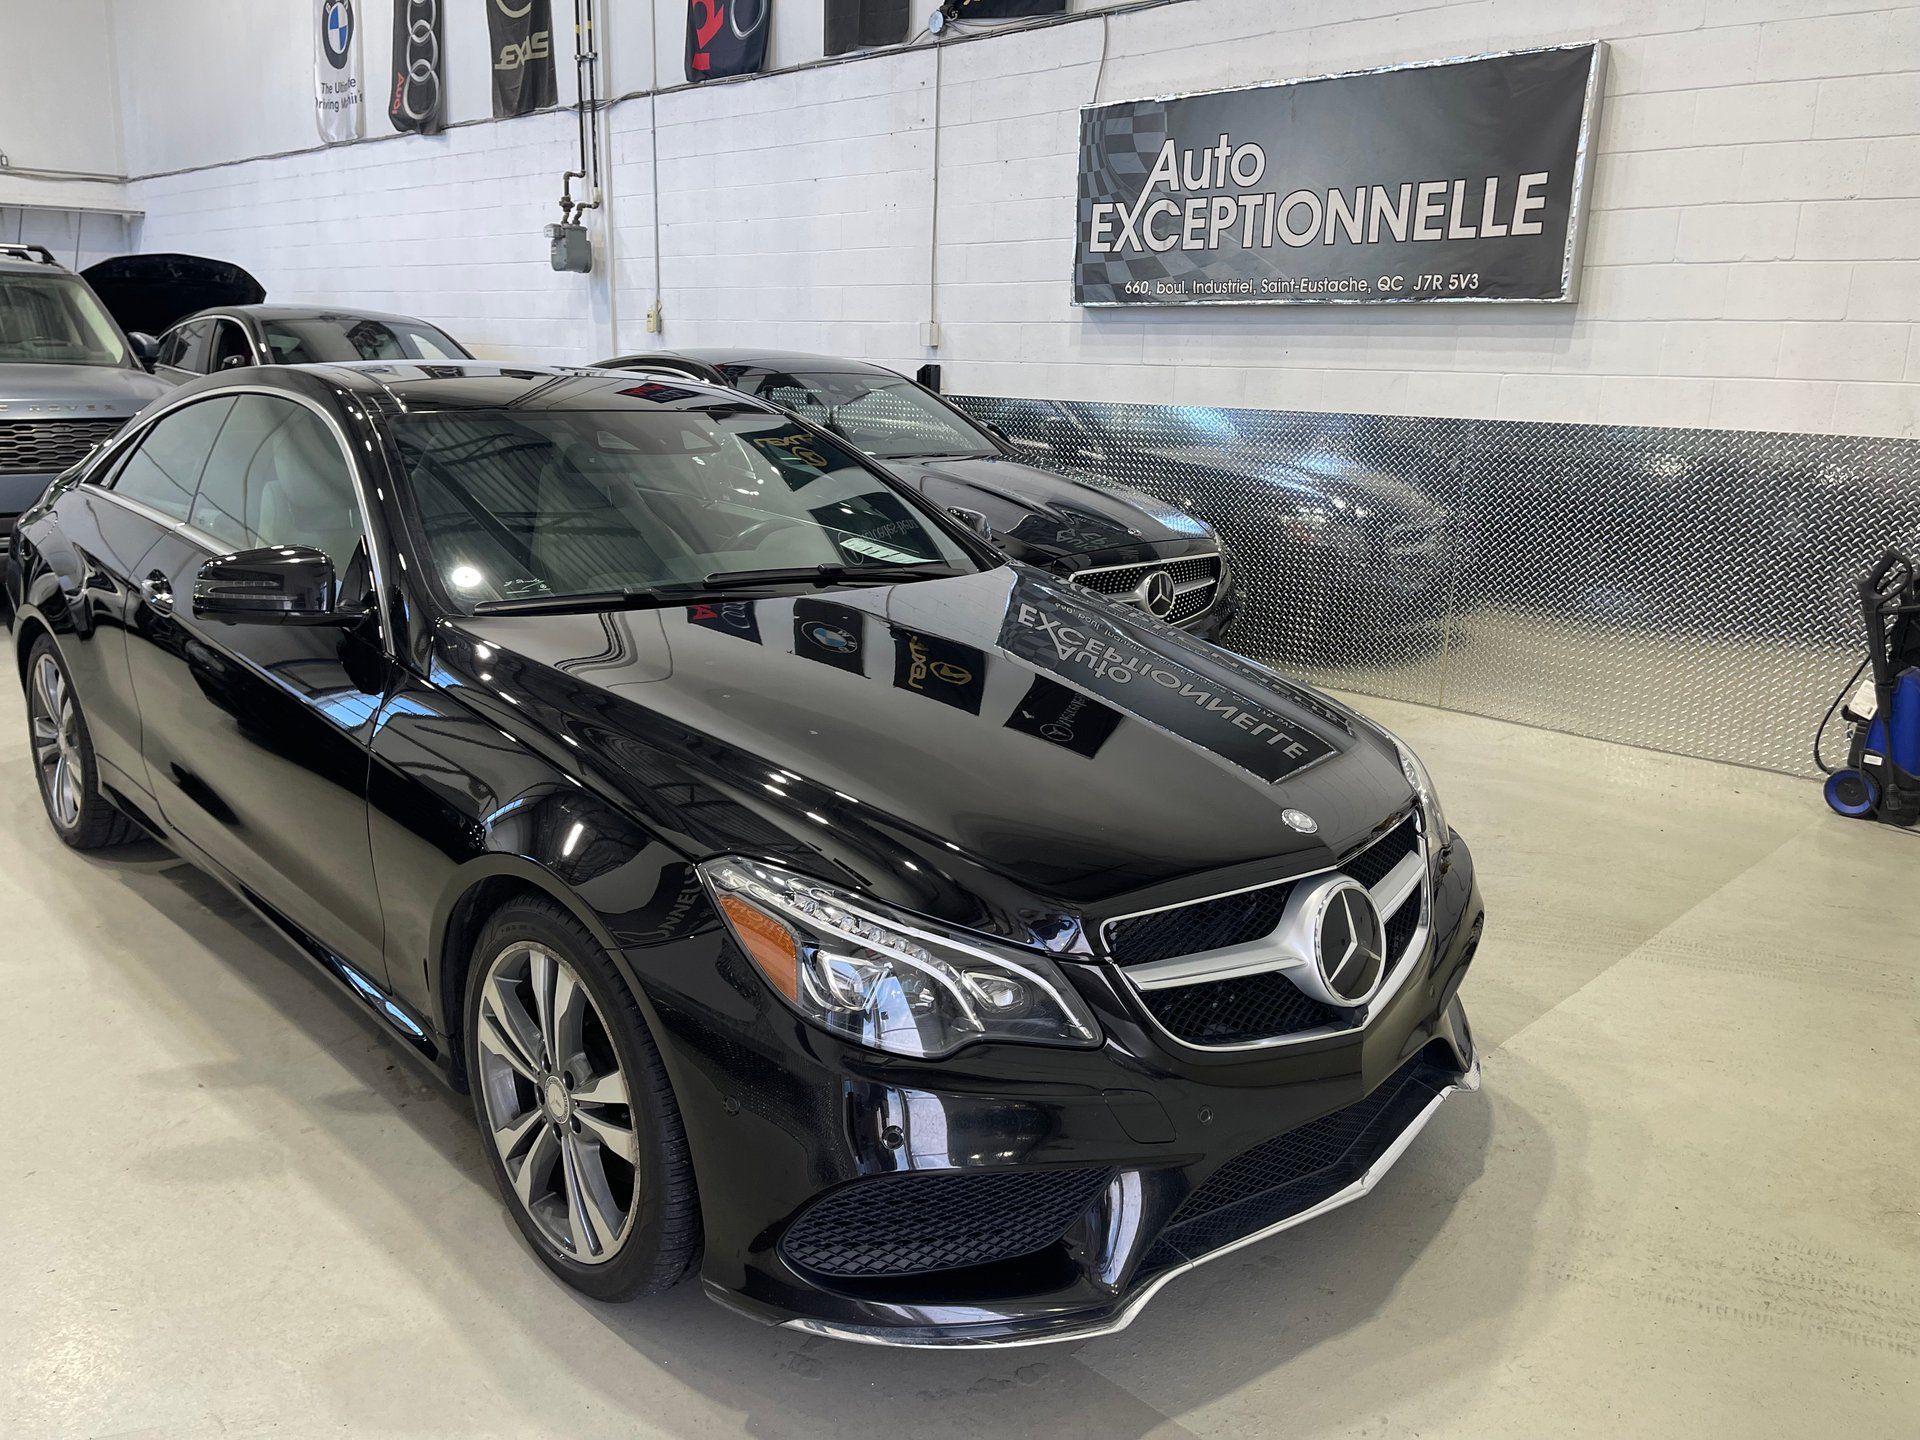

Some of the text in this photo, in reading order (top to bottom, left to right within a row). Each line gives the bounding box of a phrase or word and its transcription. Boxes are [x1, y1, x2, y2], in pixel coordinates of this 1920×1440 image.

[320, 82, 333, 94] The
[1146, 132, 1266, 193] Auto
[1089, 170, 1550, 254] EXCEPTIONNELLE
[1124, 272, 1480, 296] 660, boul. Industriel, Saint-Eustache, QC J7R 5V3
